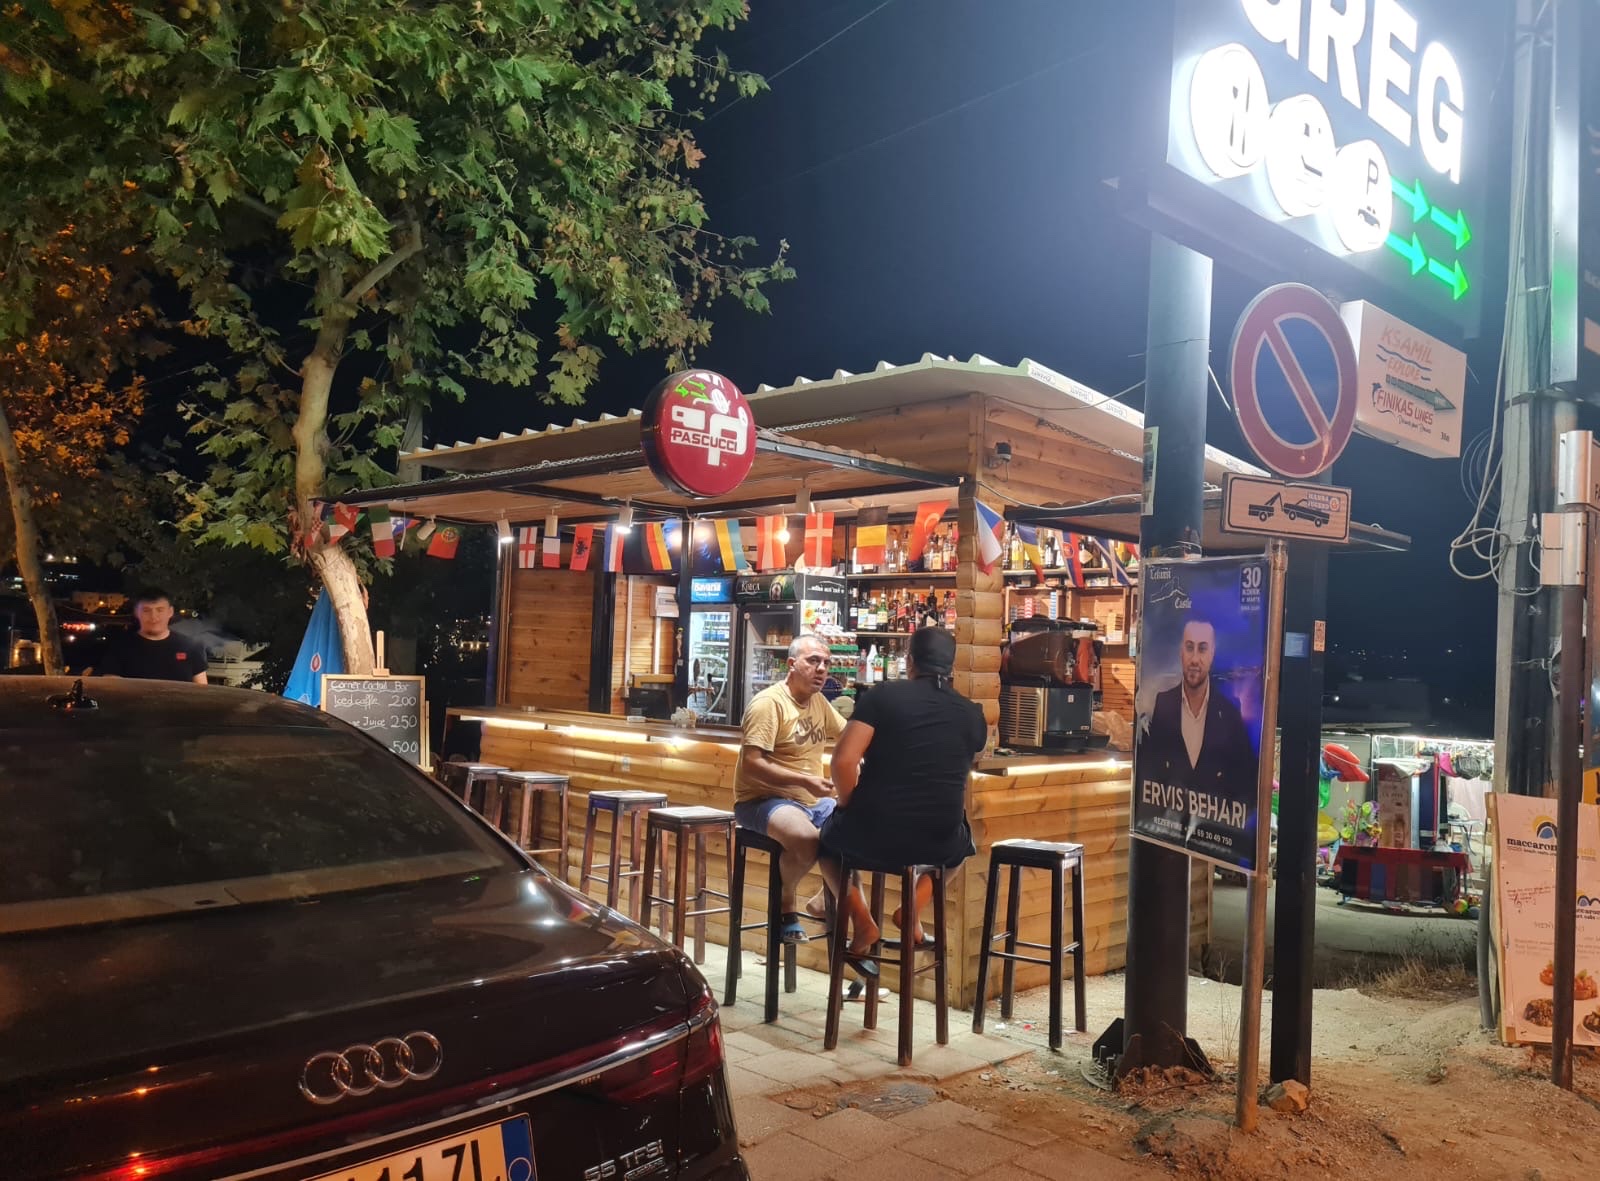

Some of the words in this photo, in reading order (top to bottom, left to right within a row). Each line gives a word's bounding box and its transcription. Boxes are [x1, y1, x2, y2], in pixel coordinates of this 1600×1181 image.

[1381, 324, 1432, 364] KSAMIL
[1387, 357, 1420, 380] EXPLORE
[1377, 390, 1414, 417] FINIKAS
[672, 430, 737, 452] PASCUCCI
[1242, 566, 1262, 588] 30
[388, 695, 417, 706] 200
[390, 715, 418, 730] 250
[392, 740, 418, 753] 500
[1142, 780, 1185, 812] ERVIS
[1188, 790, 1247, 829] BEHARI
[1506, 838, 1558, 851] maccaron
[584, 1159, 617, 1181] 55
